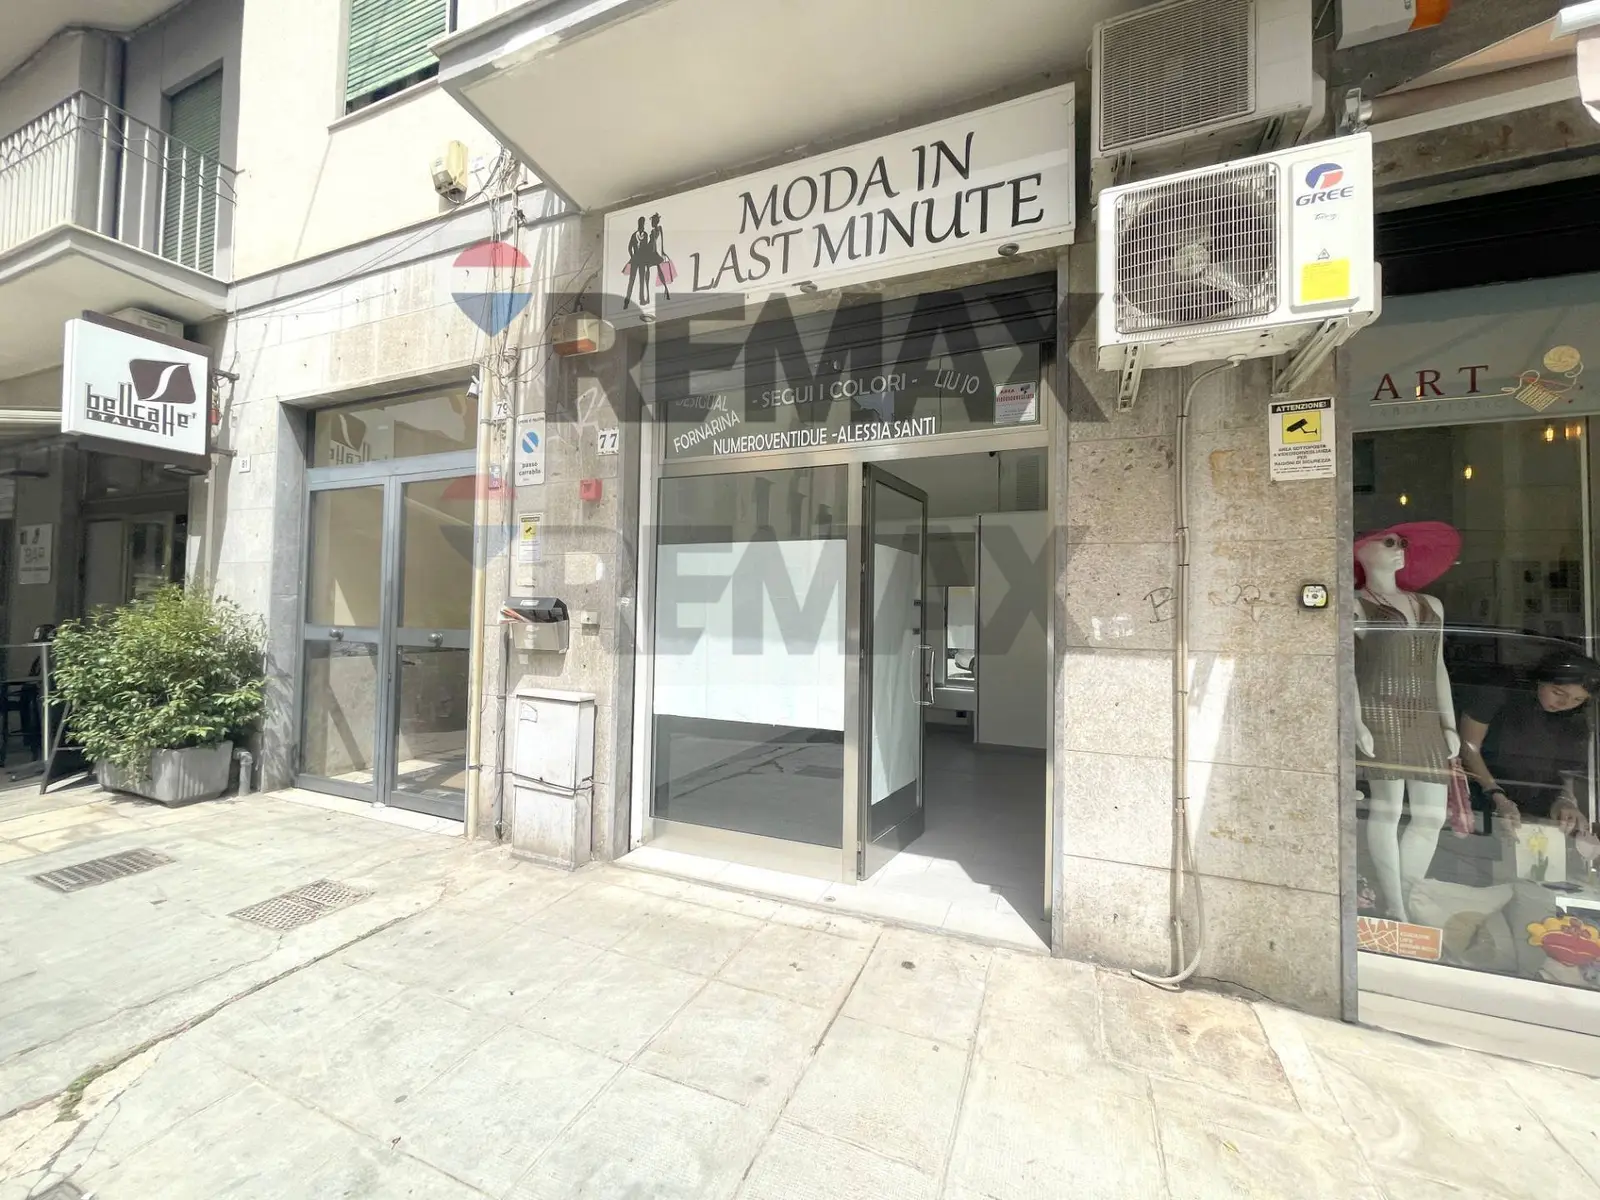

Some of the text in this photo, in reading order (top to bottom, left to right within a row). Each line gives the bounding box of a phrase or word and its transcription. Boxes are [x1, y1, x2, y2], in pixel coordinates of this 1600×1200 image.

[739, 131, 975, 234] MODA IN
[1295, 185, 1354, 206] GREE
[689, 173, 1044, 292] LAST MINUTE
[762, 387, 814, 408] SEGUI
[830, 373, 906, 399] COLORI
[935, 368, 960, 390] LIU
[960, 371, 980, 394] JO
[1370, 365, 1489, 401] ART
[87, 410, 159, 432] ITALIA
[497, 402, 508, 415] 79
[1275, 401, 1327, 412] ATTENZIONE!
[599, 432, 618, 449] 77
[673, 410, 741, 453] FORNARINA
[713, 428, 827, 455] NUMEROVENTIDUE
[894, 416, 936, 437] SANTI
